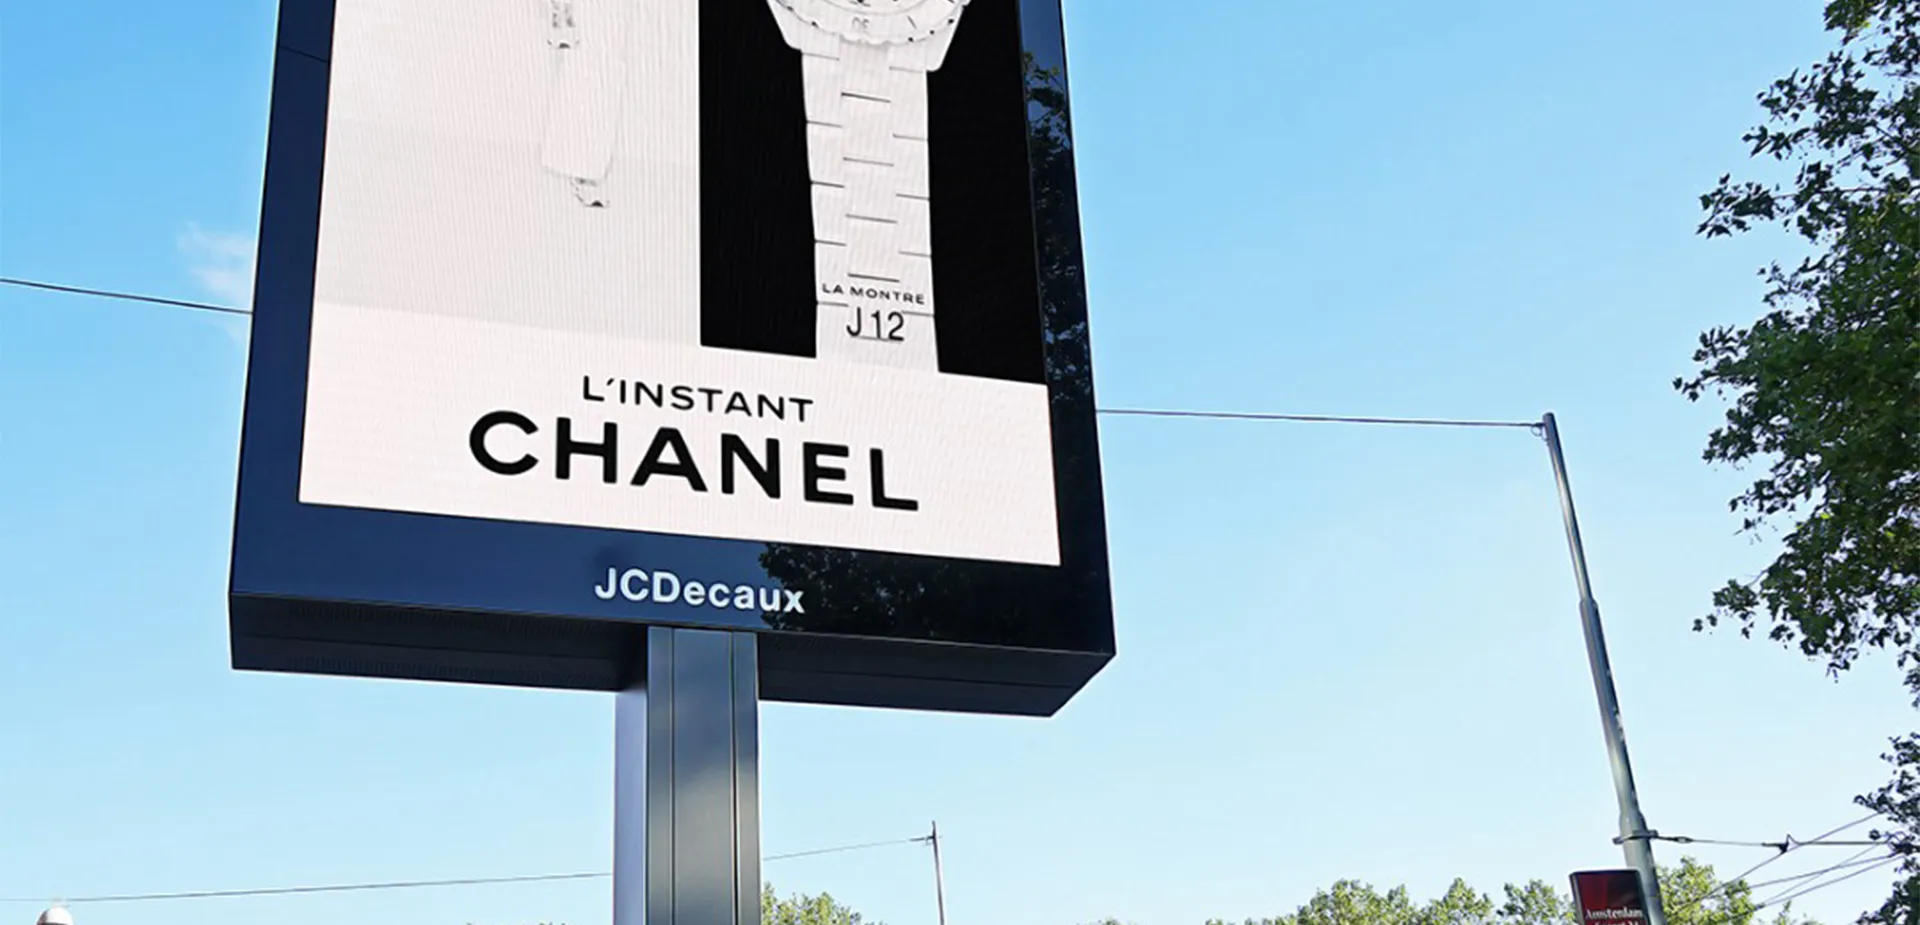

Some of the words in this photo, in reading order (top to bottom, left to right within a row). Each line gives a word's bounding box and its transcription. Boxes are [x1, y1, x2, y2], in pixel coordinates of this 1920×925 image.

[821, 283, 844, 295] LA
[849, 286, 925, 305] MONTRE
[846, 306, 904, 341] J12
[469, 410, 918, 511] CHANEL
[594, 567, 805, 614] JCDecaux
